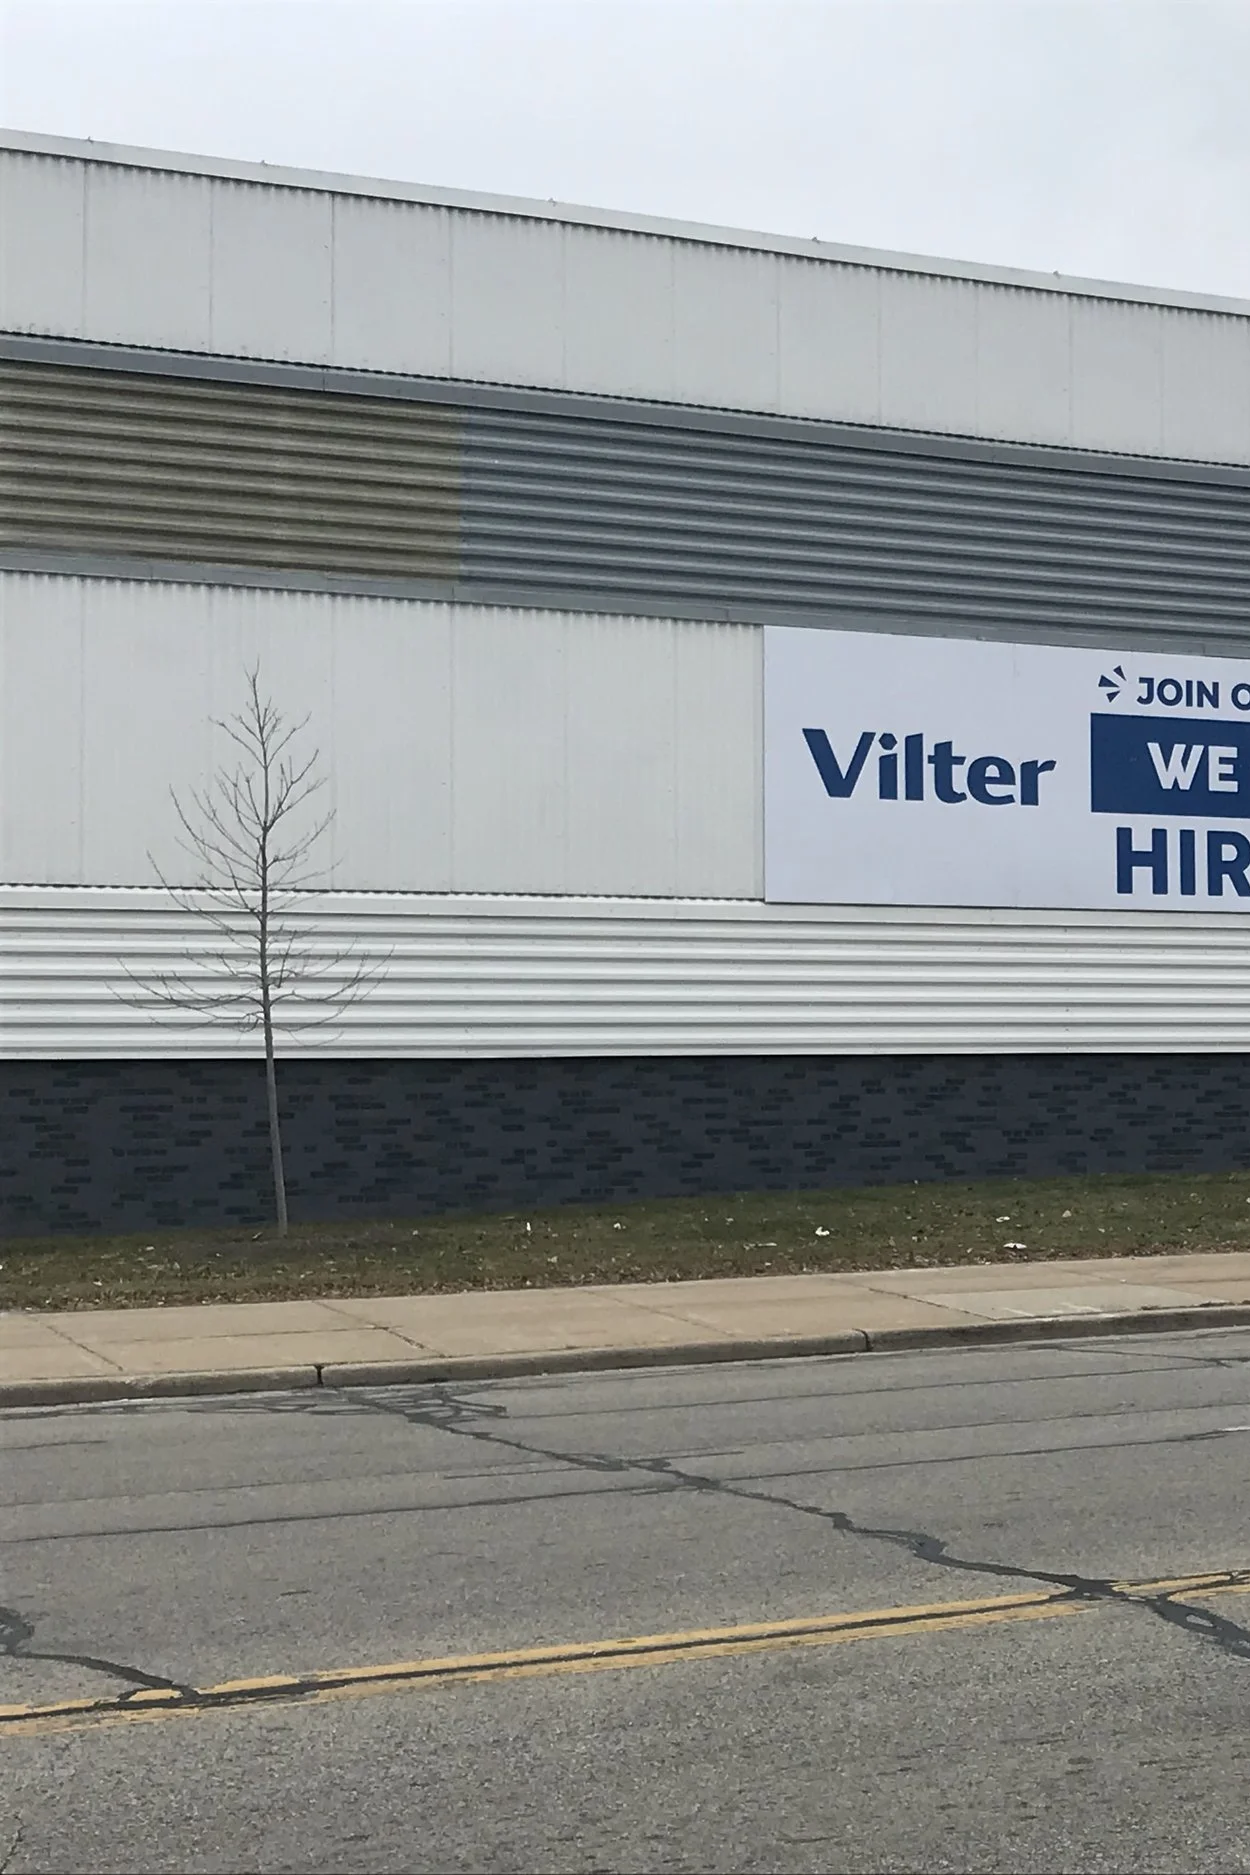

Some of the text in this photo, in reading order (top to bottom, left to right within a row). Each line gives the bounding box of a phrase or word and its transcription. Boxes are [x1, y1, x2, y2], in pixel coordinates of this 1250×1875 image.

[1136, 676, 1220, 709] JOIN
[801, 727, 1057, 807] Vilter
[1148, 743, 1238, 793] WE
